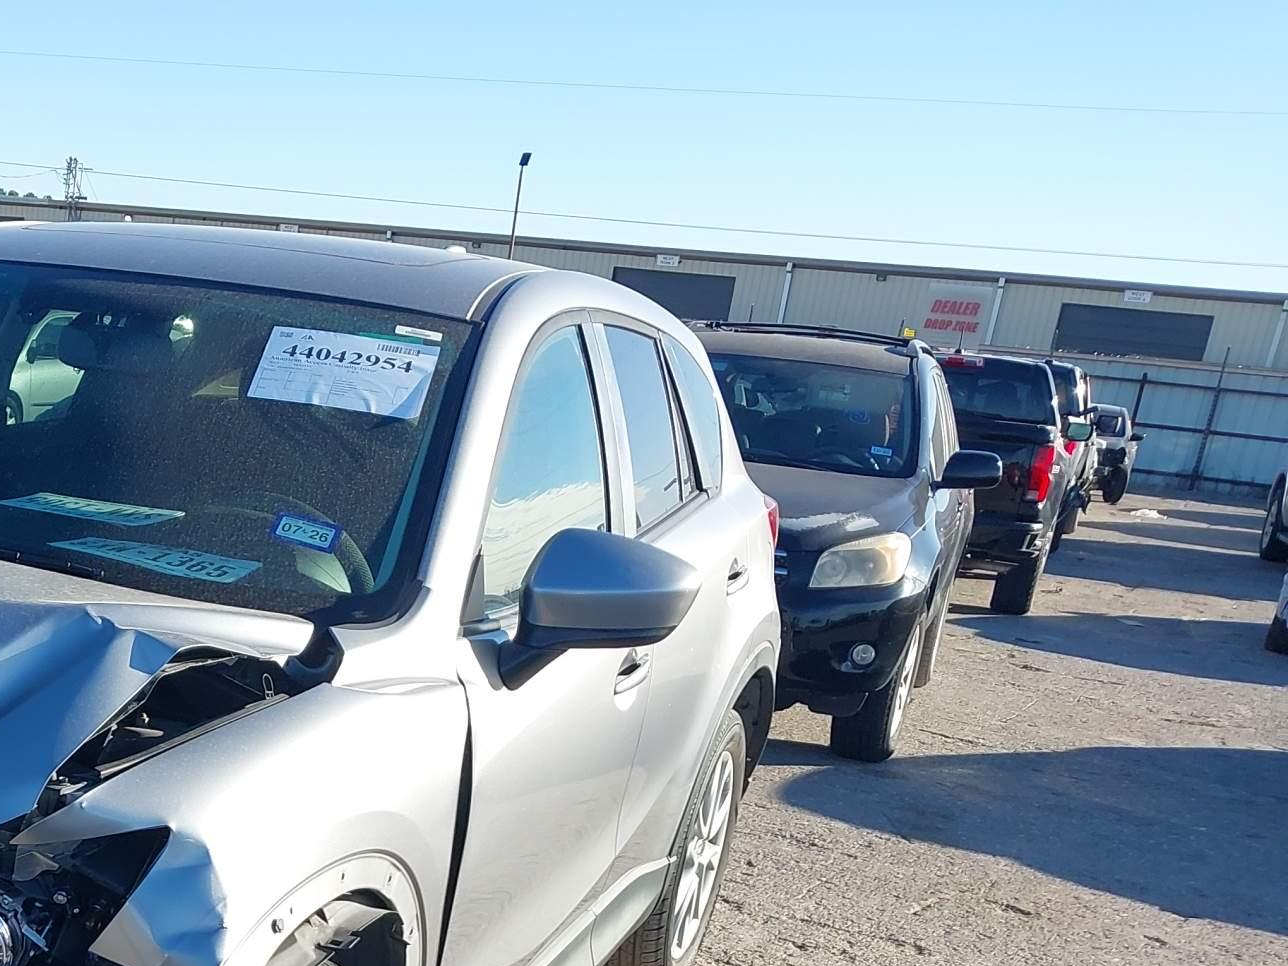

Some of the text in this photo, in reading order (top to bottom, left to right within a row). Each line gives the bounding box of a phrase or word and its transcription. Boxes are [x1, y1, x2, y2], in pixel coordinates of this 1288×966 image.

[930, 299, 981, 316] DEALER
[924, 318, 980, 333] DROP ZONE
[282, 344, 413, 373] 44042954
